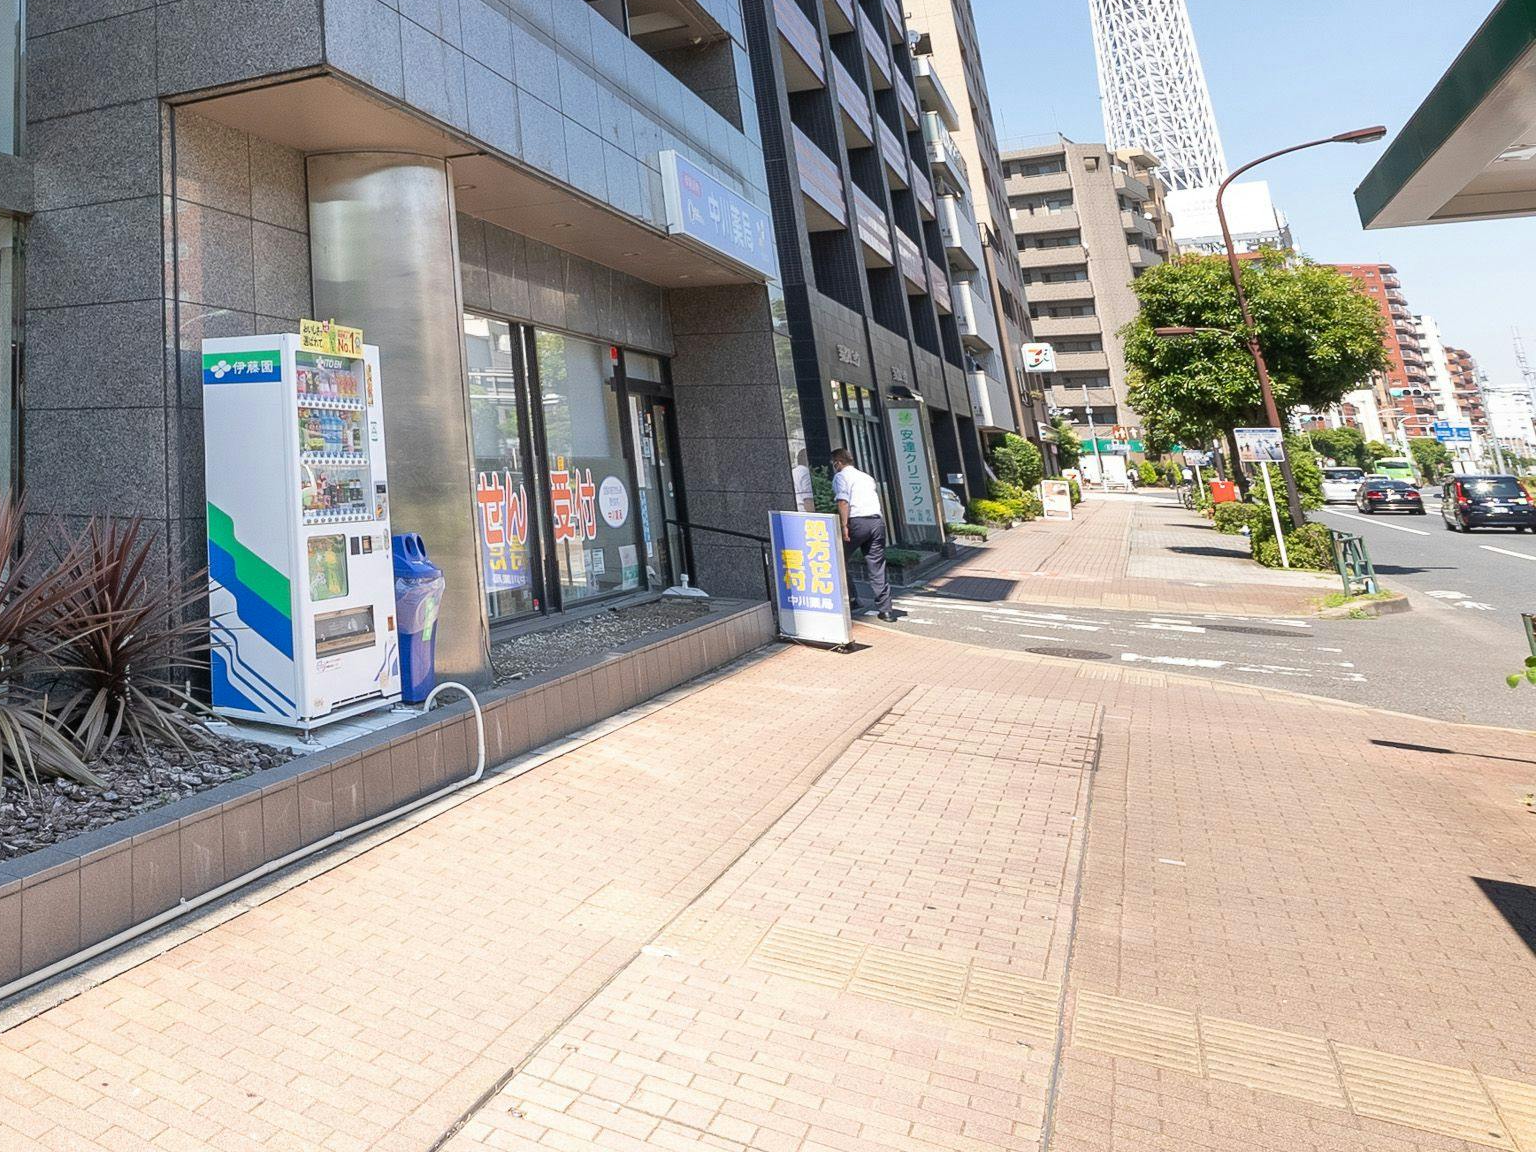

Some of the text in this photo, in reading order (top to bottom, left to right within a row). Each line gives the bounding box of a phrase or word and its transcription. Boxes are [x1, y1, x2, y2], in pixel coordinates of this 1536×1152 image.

[337, 332, 355, 354] No.1
[232, 359, 273, 375] 伊藤園
[549, 467, 597, 544] 受付
